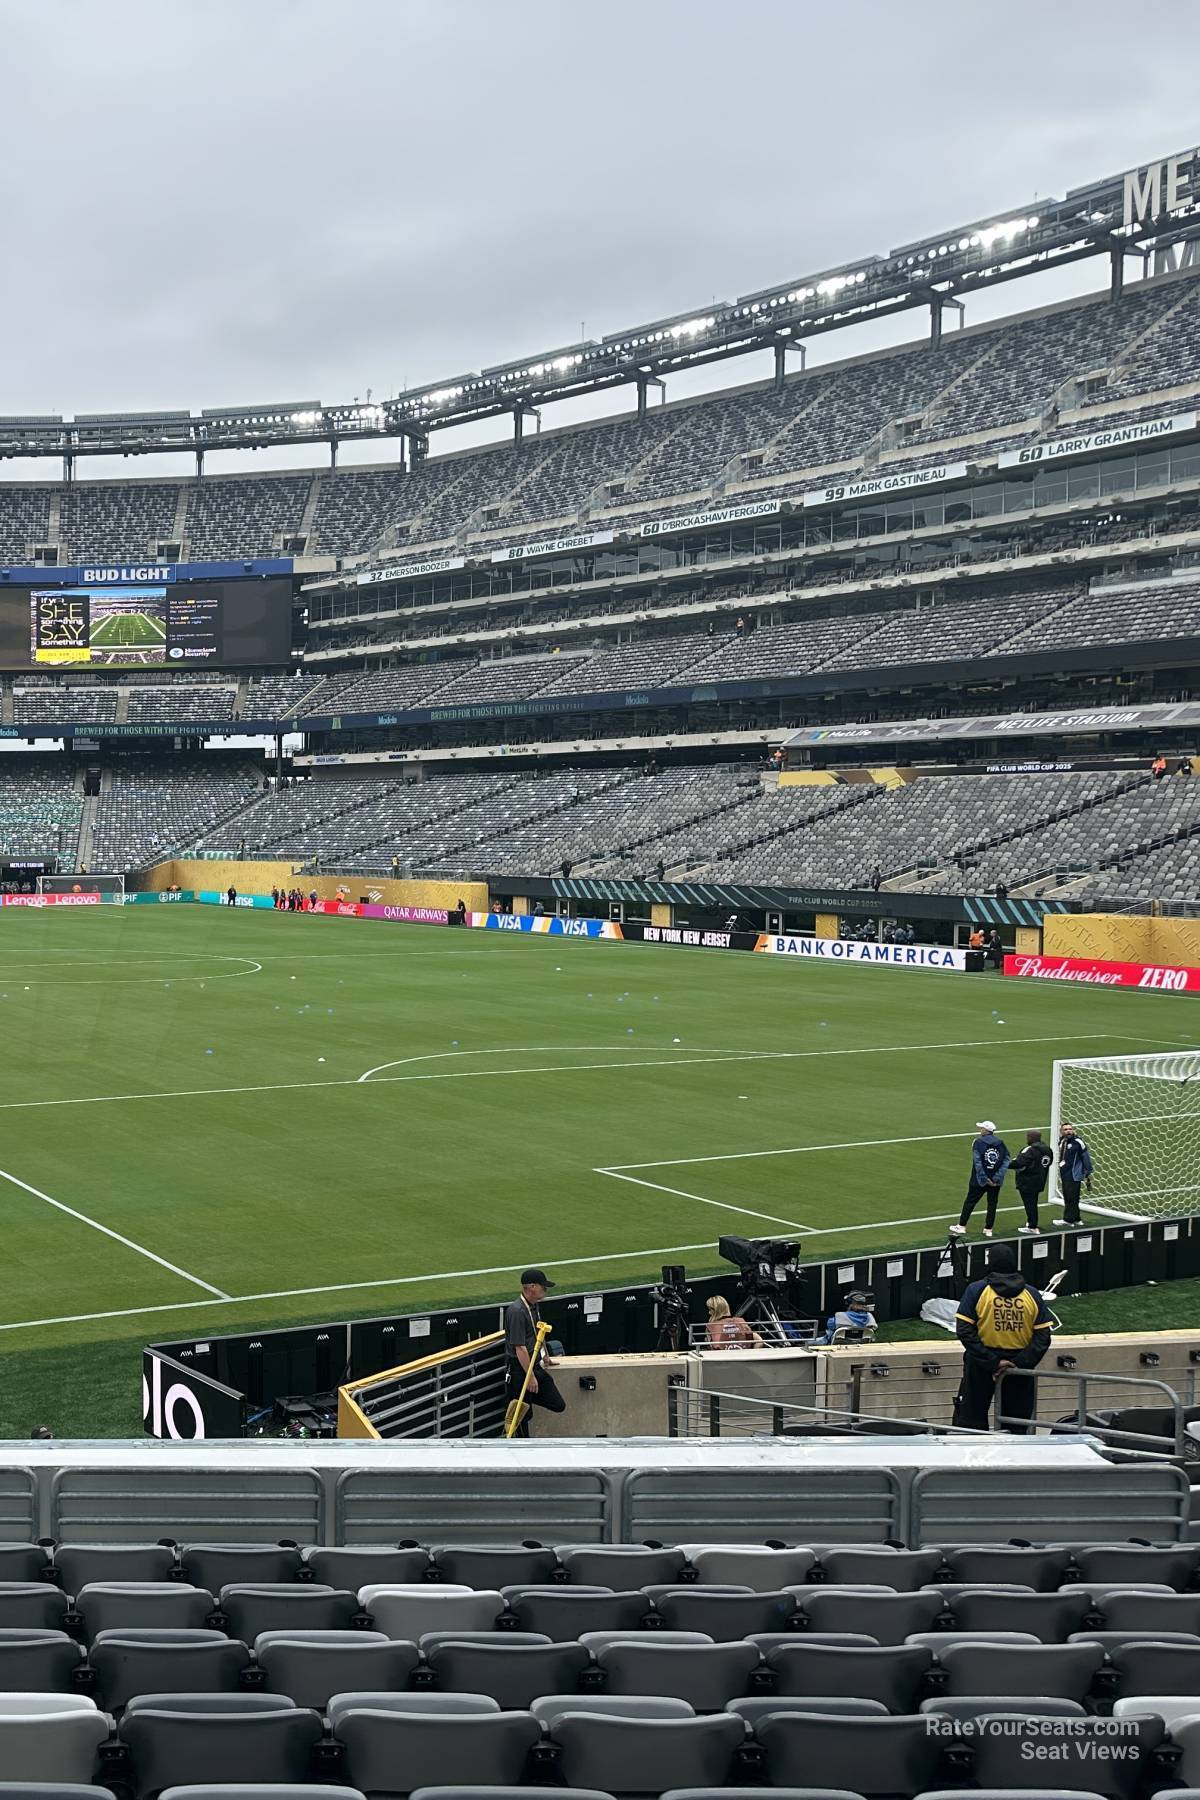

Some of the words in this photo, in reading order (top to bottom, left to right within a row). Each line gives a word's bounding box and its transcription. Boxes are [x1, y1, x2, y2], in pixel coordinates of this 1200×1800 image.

[1123, 150, 1200, 225] ME
[1018, 447, 1043, 463] 60
[1048, 437, 1091, 455] LARRY
[1094, 420, 1173, 446] GRANTHAM
[825, 488, 845, 501] 99
[849, 479, 882, 496] MARK
[883, 468, 946, 489] GASTINEAU
[643, 522, 659, 536] 60
[662, 510, 728, 531] D'BRICKASHAW
[729, 503, 777, 518] FERGUSON
[508, 549, 523, 559] 80
[526, 543, 556, 556] WAYNE
[557, 535, 594, 549] CHREBET
[84, 568, 119, 582] BUD
[121, 567, 170, 580] LIGHT
[369, 571, 382, 582] 32
[385, 566, 420, 579] EMERSON
[420, 561, 450, 573] BOOZER
[40, 624, 85, 640] SAY
[431, 710, 457, 720] BREWED
[458, 708, 470, 718] FOR
[472, 706, 493, 717] THOSE
[495, 705, 513, 715] WITH
[514, 704, 527, 714] THE
[378, 715, 397, 725] Modelo
[994, 715, 1058, 730] METLIFE
[1062, 712, 1139, 727] STADIUM
[74, 727, 103, 735] BREWED
[105, 726, 118, 735] FOR
[119, 726, 143, 734] THOSE
[144, 726, 162, 734] WITH
[163, 726, 177, 734] THE
[829, 729, 872, 739] MetLife
[1018, 764, 1040, 772] WORLD
[6, 895, 47, 906] Lenovo
[56, 894, 97, 905] Lenovo
[123, 894, 138, 903] PIF
[168, 892, 182, 901] PIF
[788, 896, 803, 904] FIFA
[822, 898, 846, 906] WORLD
[384, 906, 410, 919] QATAR
[412, 907, 448, 921] AIRWAYS
[496, 914, 522, 930] VISA
[560, 919, 588, 935] VISA
[644, 927, 657, 941] NEW
[658, 928, 681, 943] YORK
[683, 930, 699, 944] NEW
[702, 932, 731, 948] JERSEY
[776, 938, 825, 956] BANK
[831, 943, 854, 959] OF
[860, 945, 955, 967] AMERICA
[1015, 956, 1123, 986] Budweiser
[1138, 967, 1188, 990] ZERO
[993, 1296, 1024, 1309] CSC
[994, 1310, 1024, 1320] EVENT
[994, 1321, 1024, 1332] STAFF
